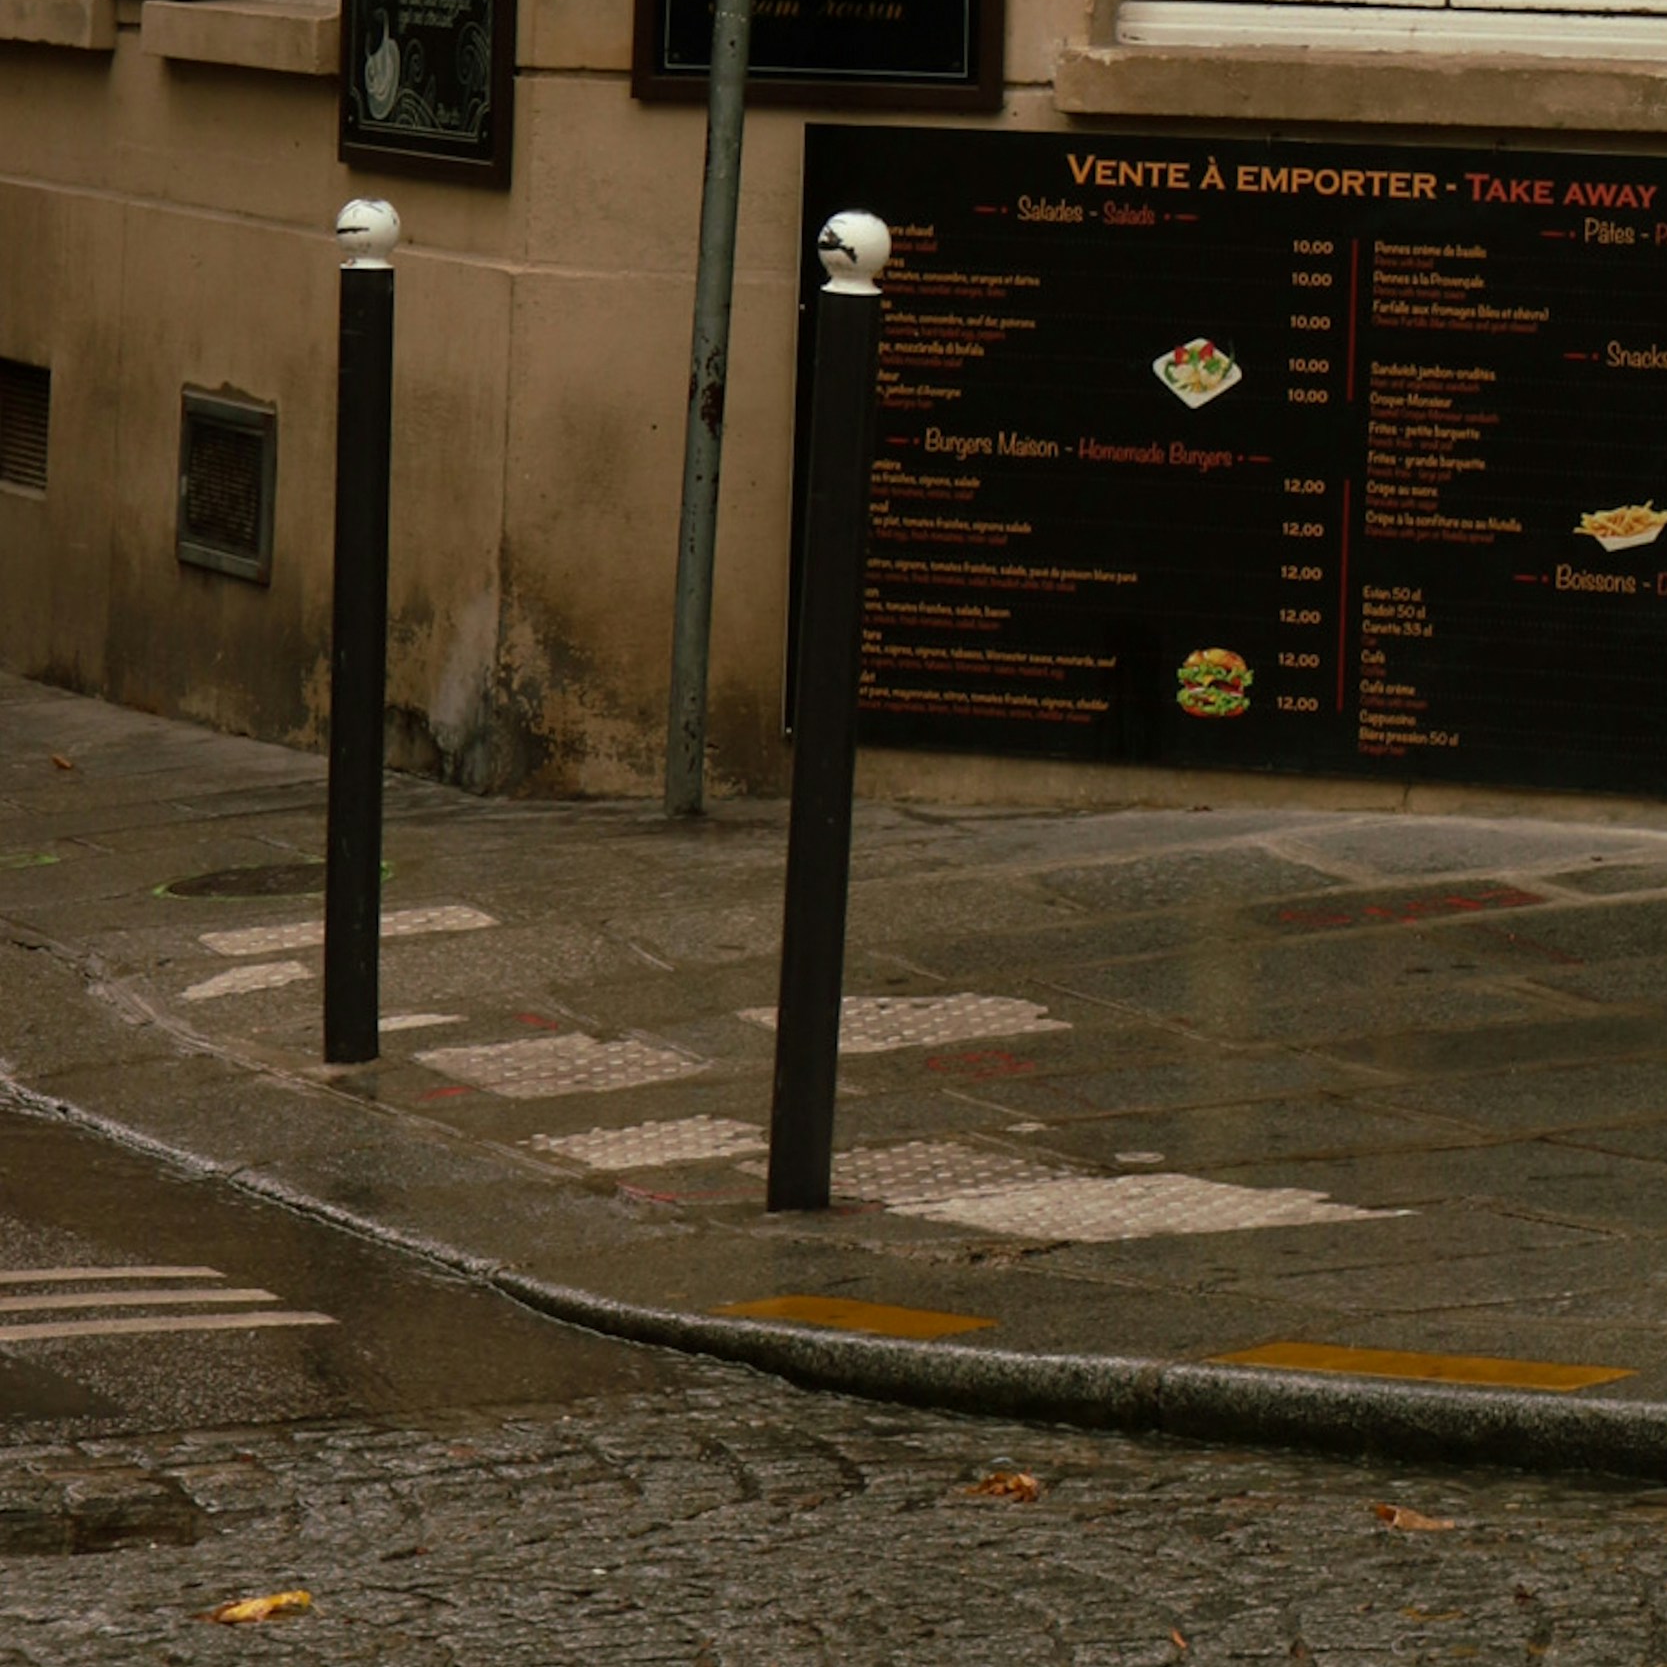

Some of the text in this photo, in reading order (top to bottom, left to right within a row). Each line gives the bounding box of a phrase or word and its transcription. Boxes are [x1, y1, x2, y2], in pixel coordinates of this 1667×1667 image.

[1066, 153, 1191, 189] VENTE
[1200, 156, 1226, 191] À
[1236, 165, 1437, 200] EMPORTER
[1464, 172, 1555, 206] TAKE
[1562, 182, 1658, 209] AWAY
[1018, 195, 1084, 223] Salades
[1584, 217, 1636, 245] Pâtes
[924, 427, 1233, 472] Burgers Maison Homemade Burgers
[1555, 563, 1637, 595] Boissons
